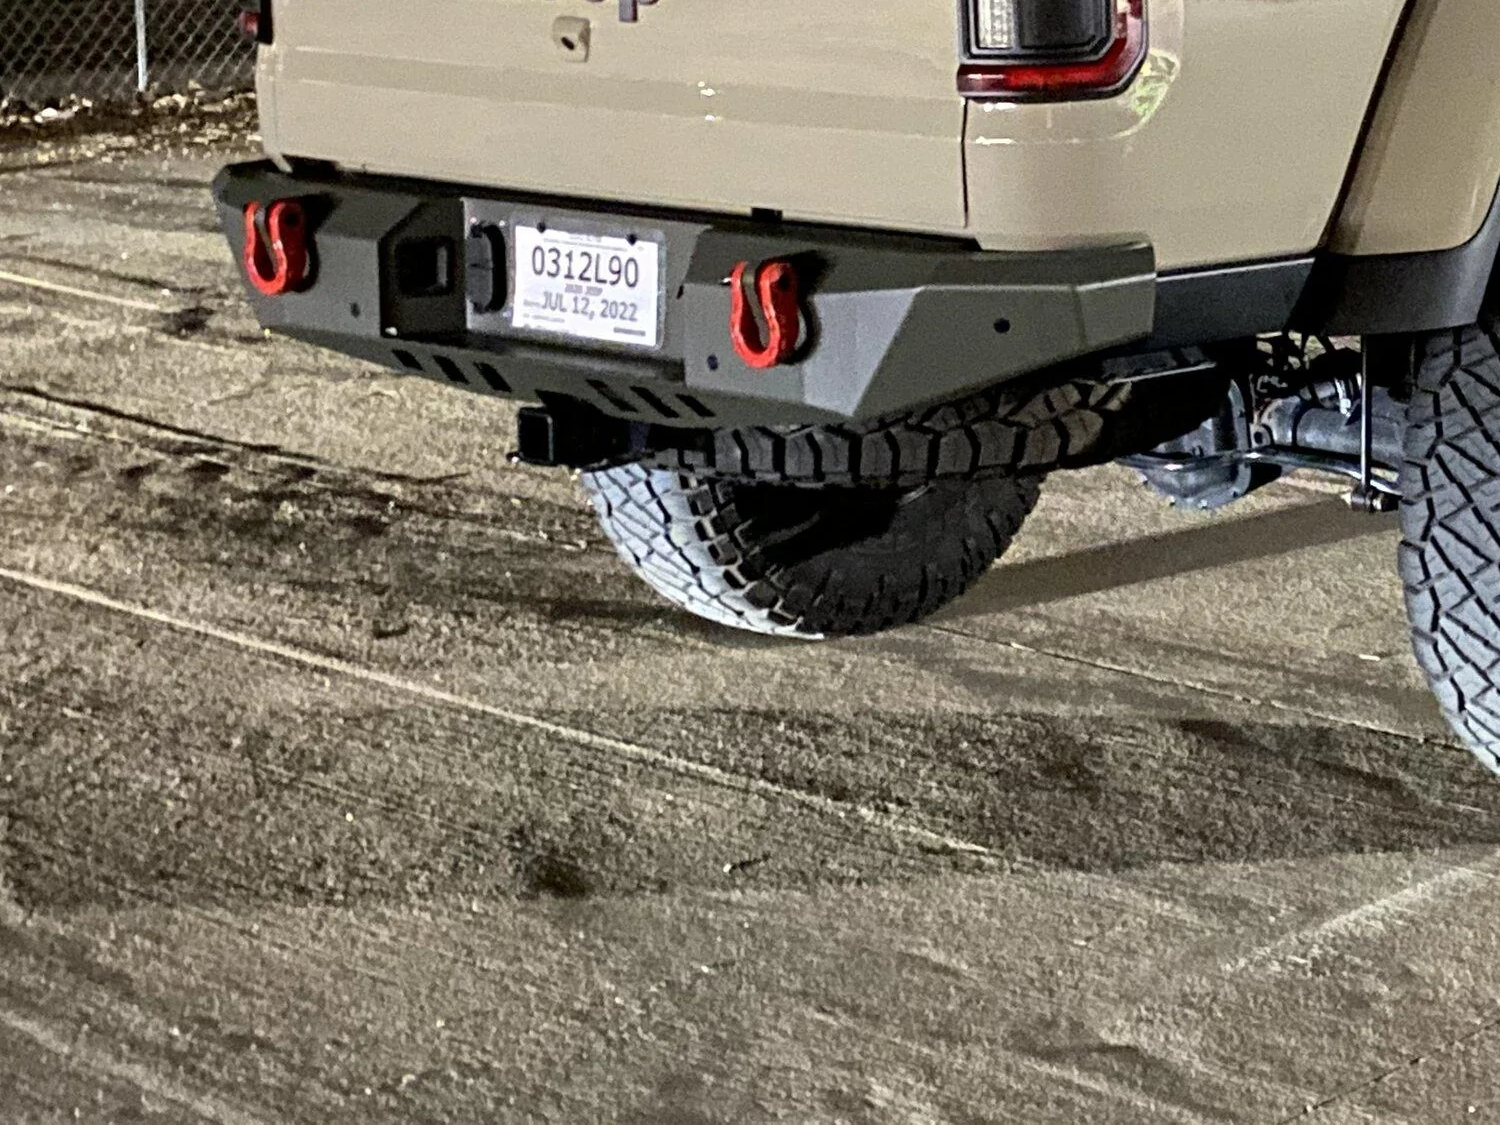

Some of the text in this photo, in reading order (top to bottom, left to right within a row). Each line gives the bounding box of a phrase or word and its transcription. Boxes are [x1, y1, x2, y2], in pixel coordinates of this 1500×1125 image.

[531, 245, 640, 288] 0312L90
[541, 291, 567, 313] JUL
[600, 298, 639, 322] 2022
